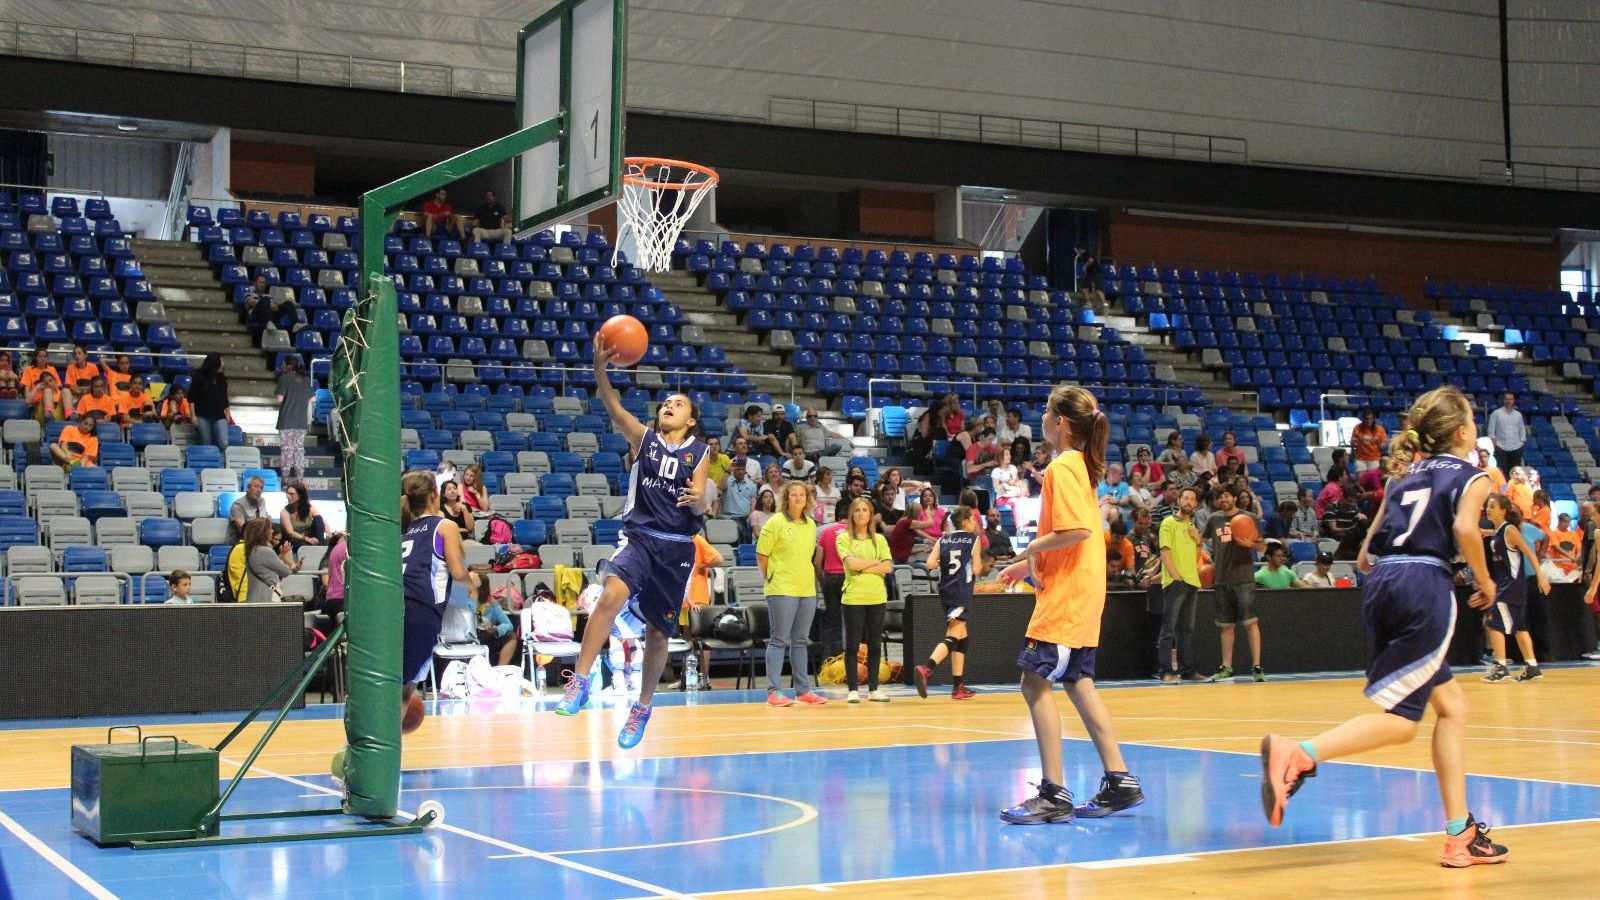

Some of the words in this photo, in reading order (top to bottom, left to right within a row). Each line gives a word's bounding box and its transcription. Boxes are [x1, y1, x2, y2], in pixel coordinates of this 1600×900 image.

[590, 109, 600, 161] 1
[658, 454, 679, 480] 10
[1407, 459, 1463, 475] ALAGA
[1391, 487, 1432, 547] 7
[948, 549, 962, 575] 5
